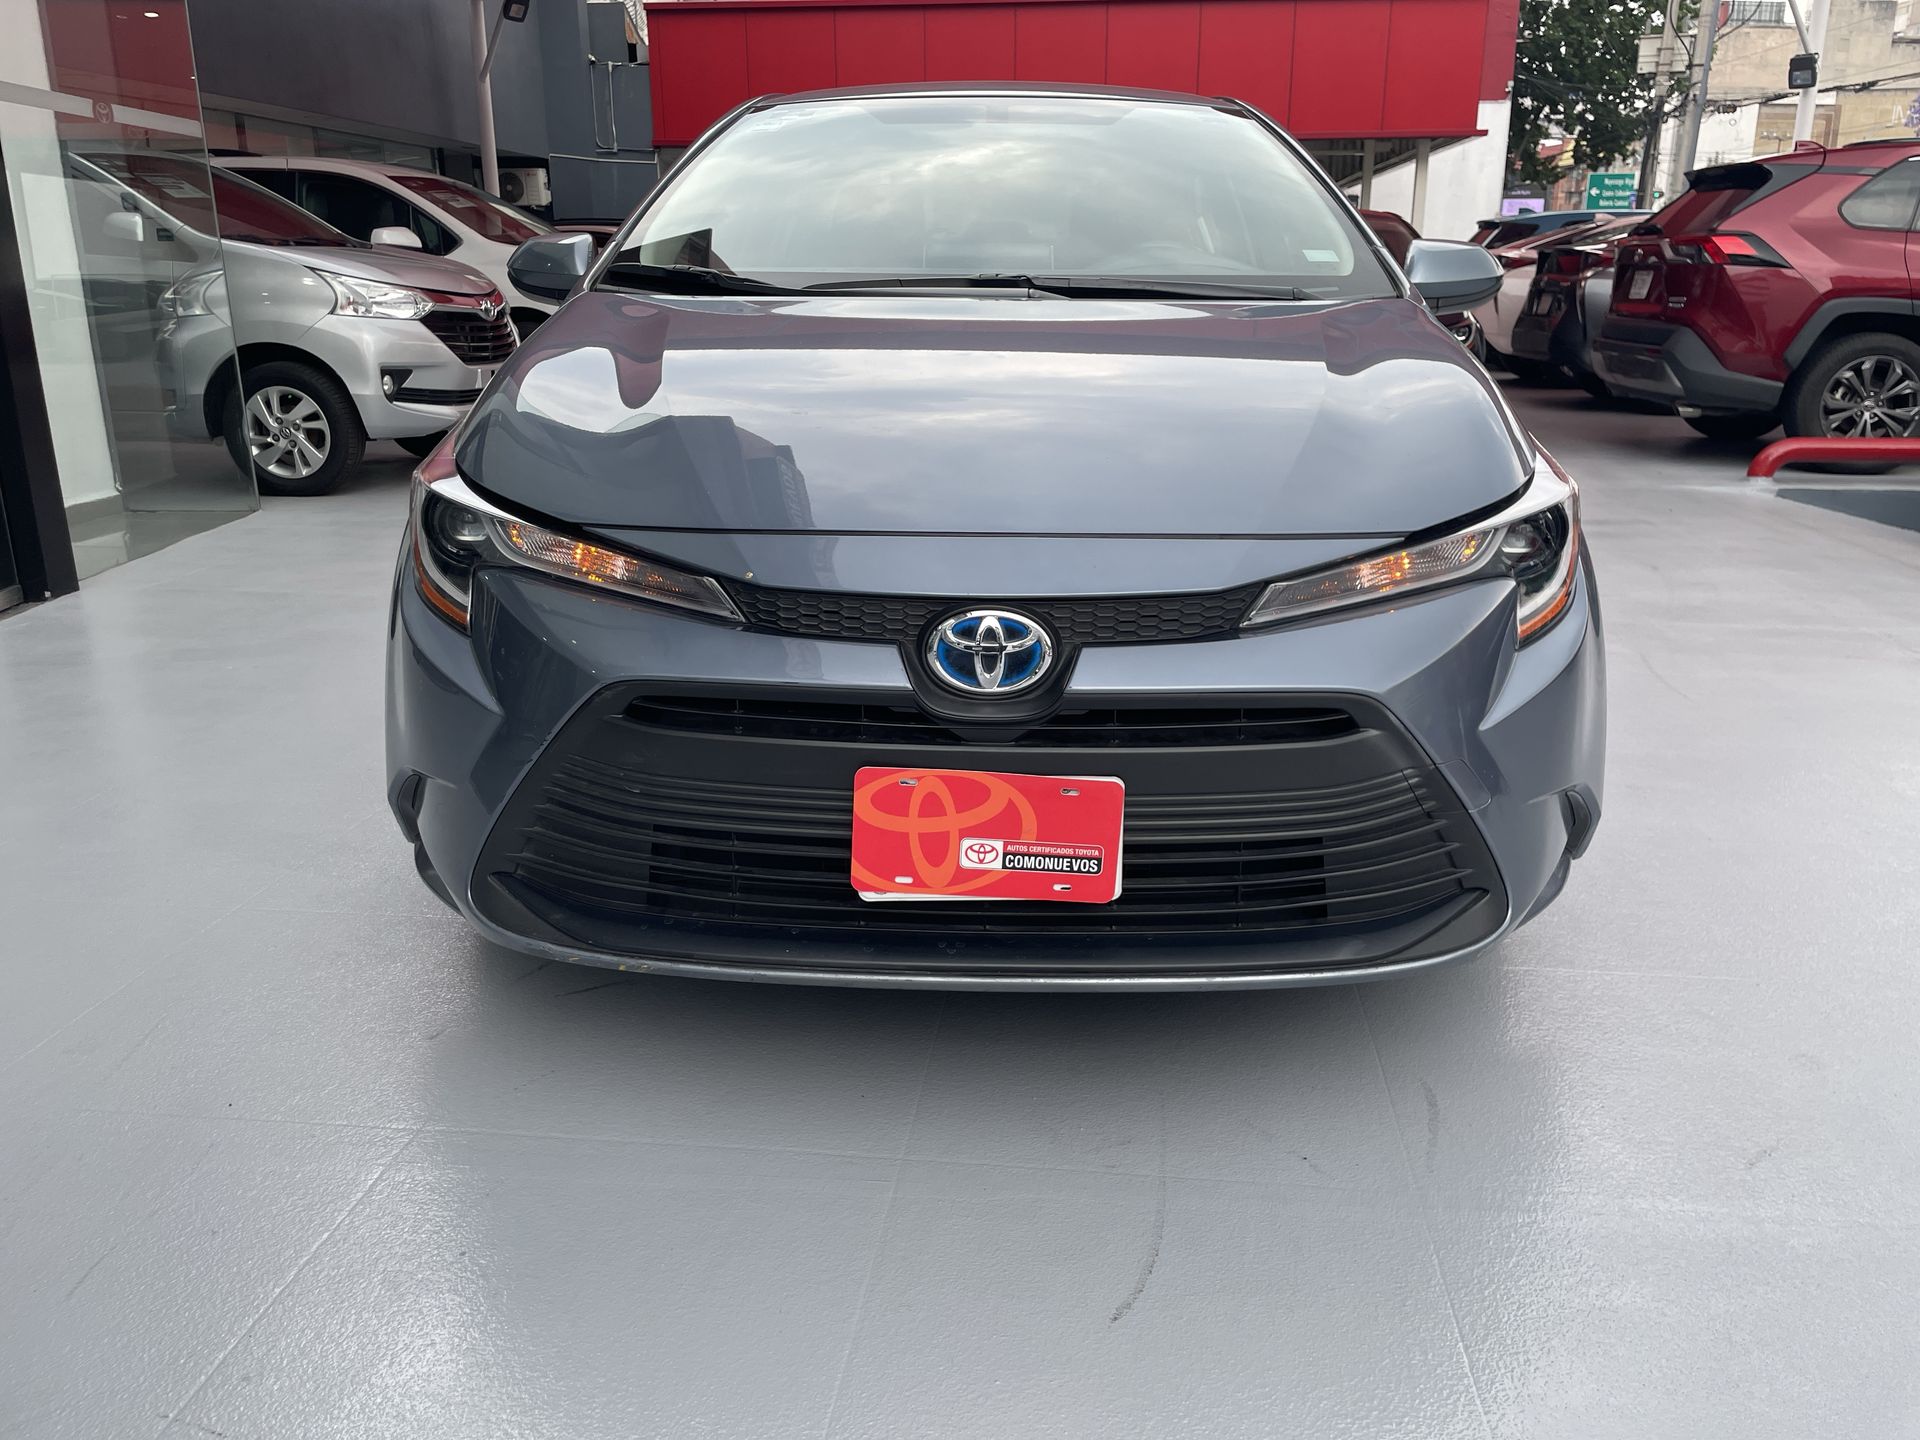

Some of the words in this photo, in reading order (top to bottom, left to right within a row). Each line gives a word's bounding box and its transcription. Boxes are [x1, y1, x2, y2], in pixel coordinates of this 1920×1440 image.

[1029, 846, 1074, 854] CERTIFICADOS
[1075, 848, 1099, 856] TOYOTA
[1005, 855, 1098, 872] COMONUEVOS
